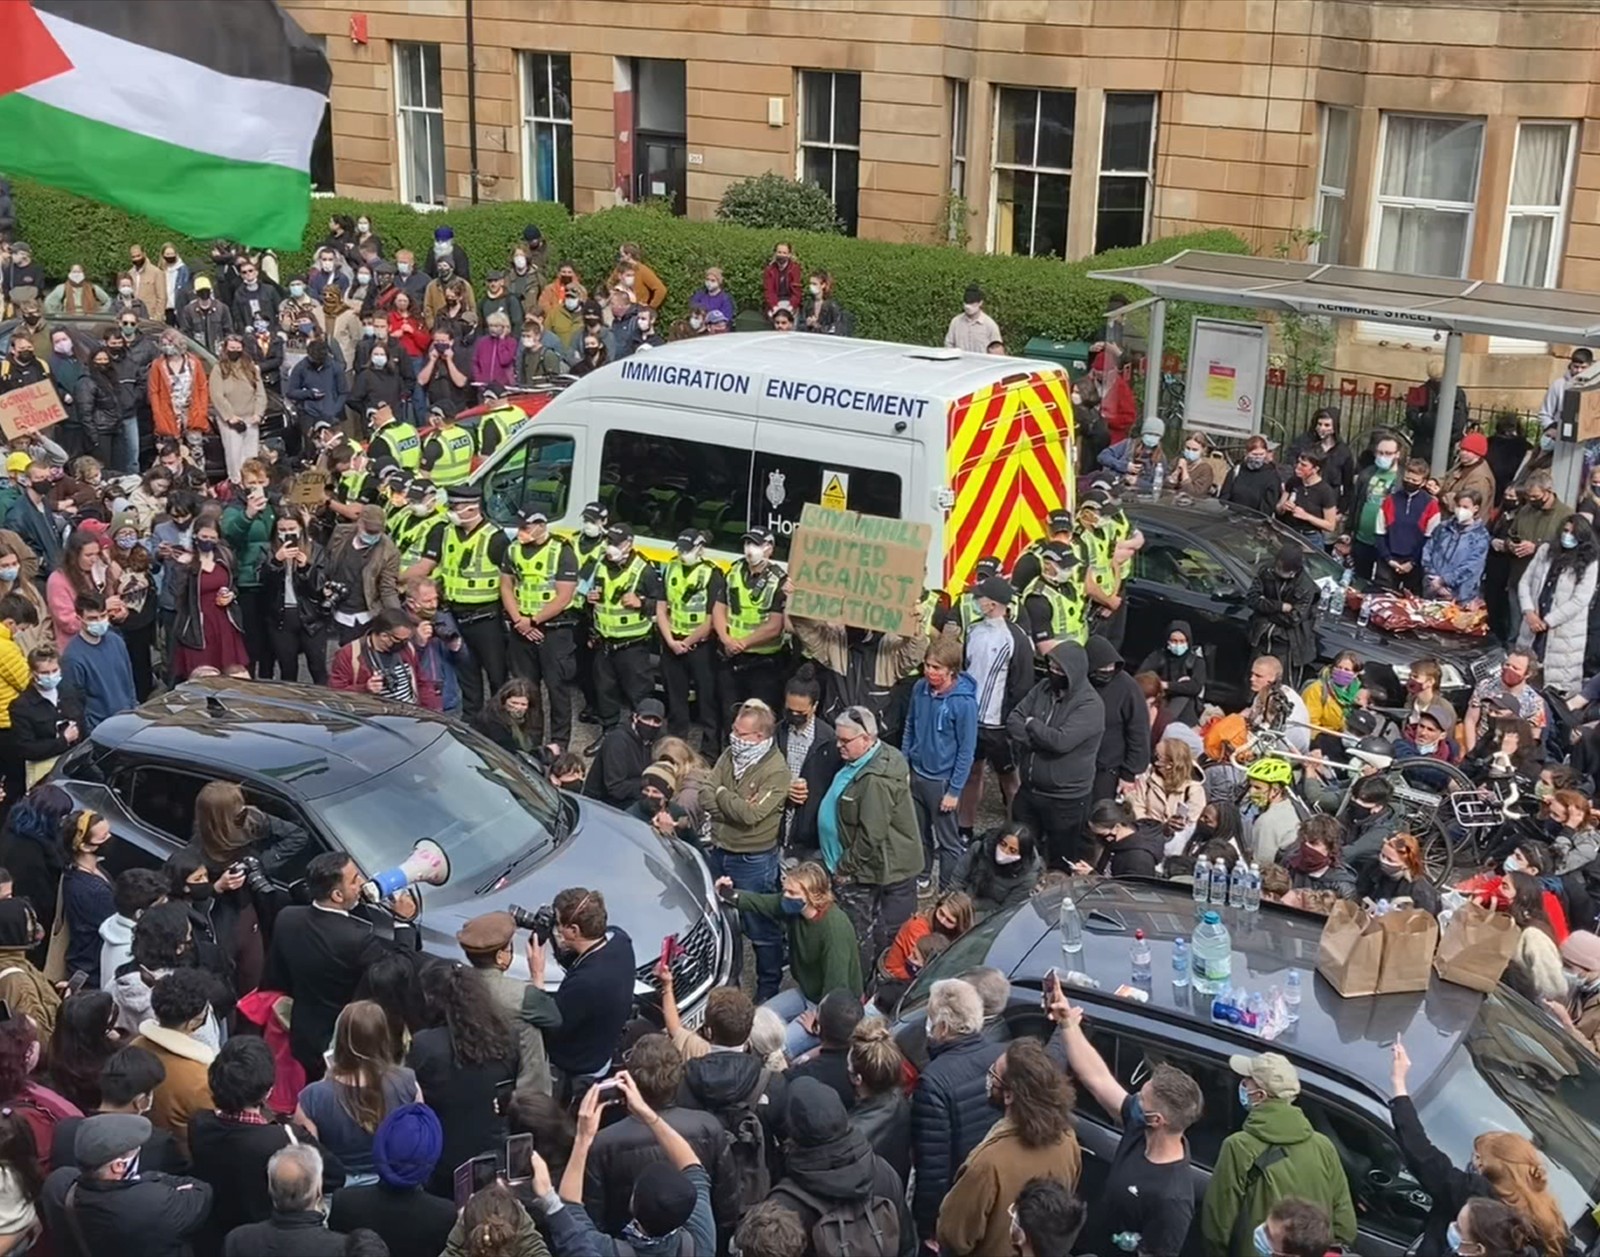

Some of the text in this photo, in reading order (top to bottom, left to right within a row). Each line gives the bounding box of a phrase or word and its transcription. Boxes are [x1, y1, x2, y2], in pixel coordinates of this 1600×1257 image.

[620, 361, 929, 418] IMMIGRATION ENFORCEMENT
[803, 534, 887, 568] UNITED
[795, 560, 914, 606] AGAINST
[791, 589, 903, 631] EVICTION
